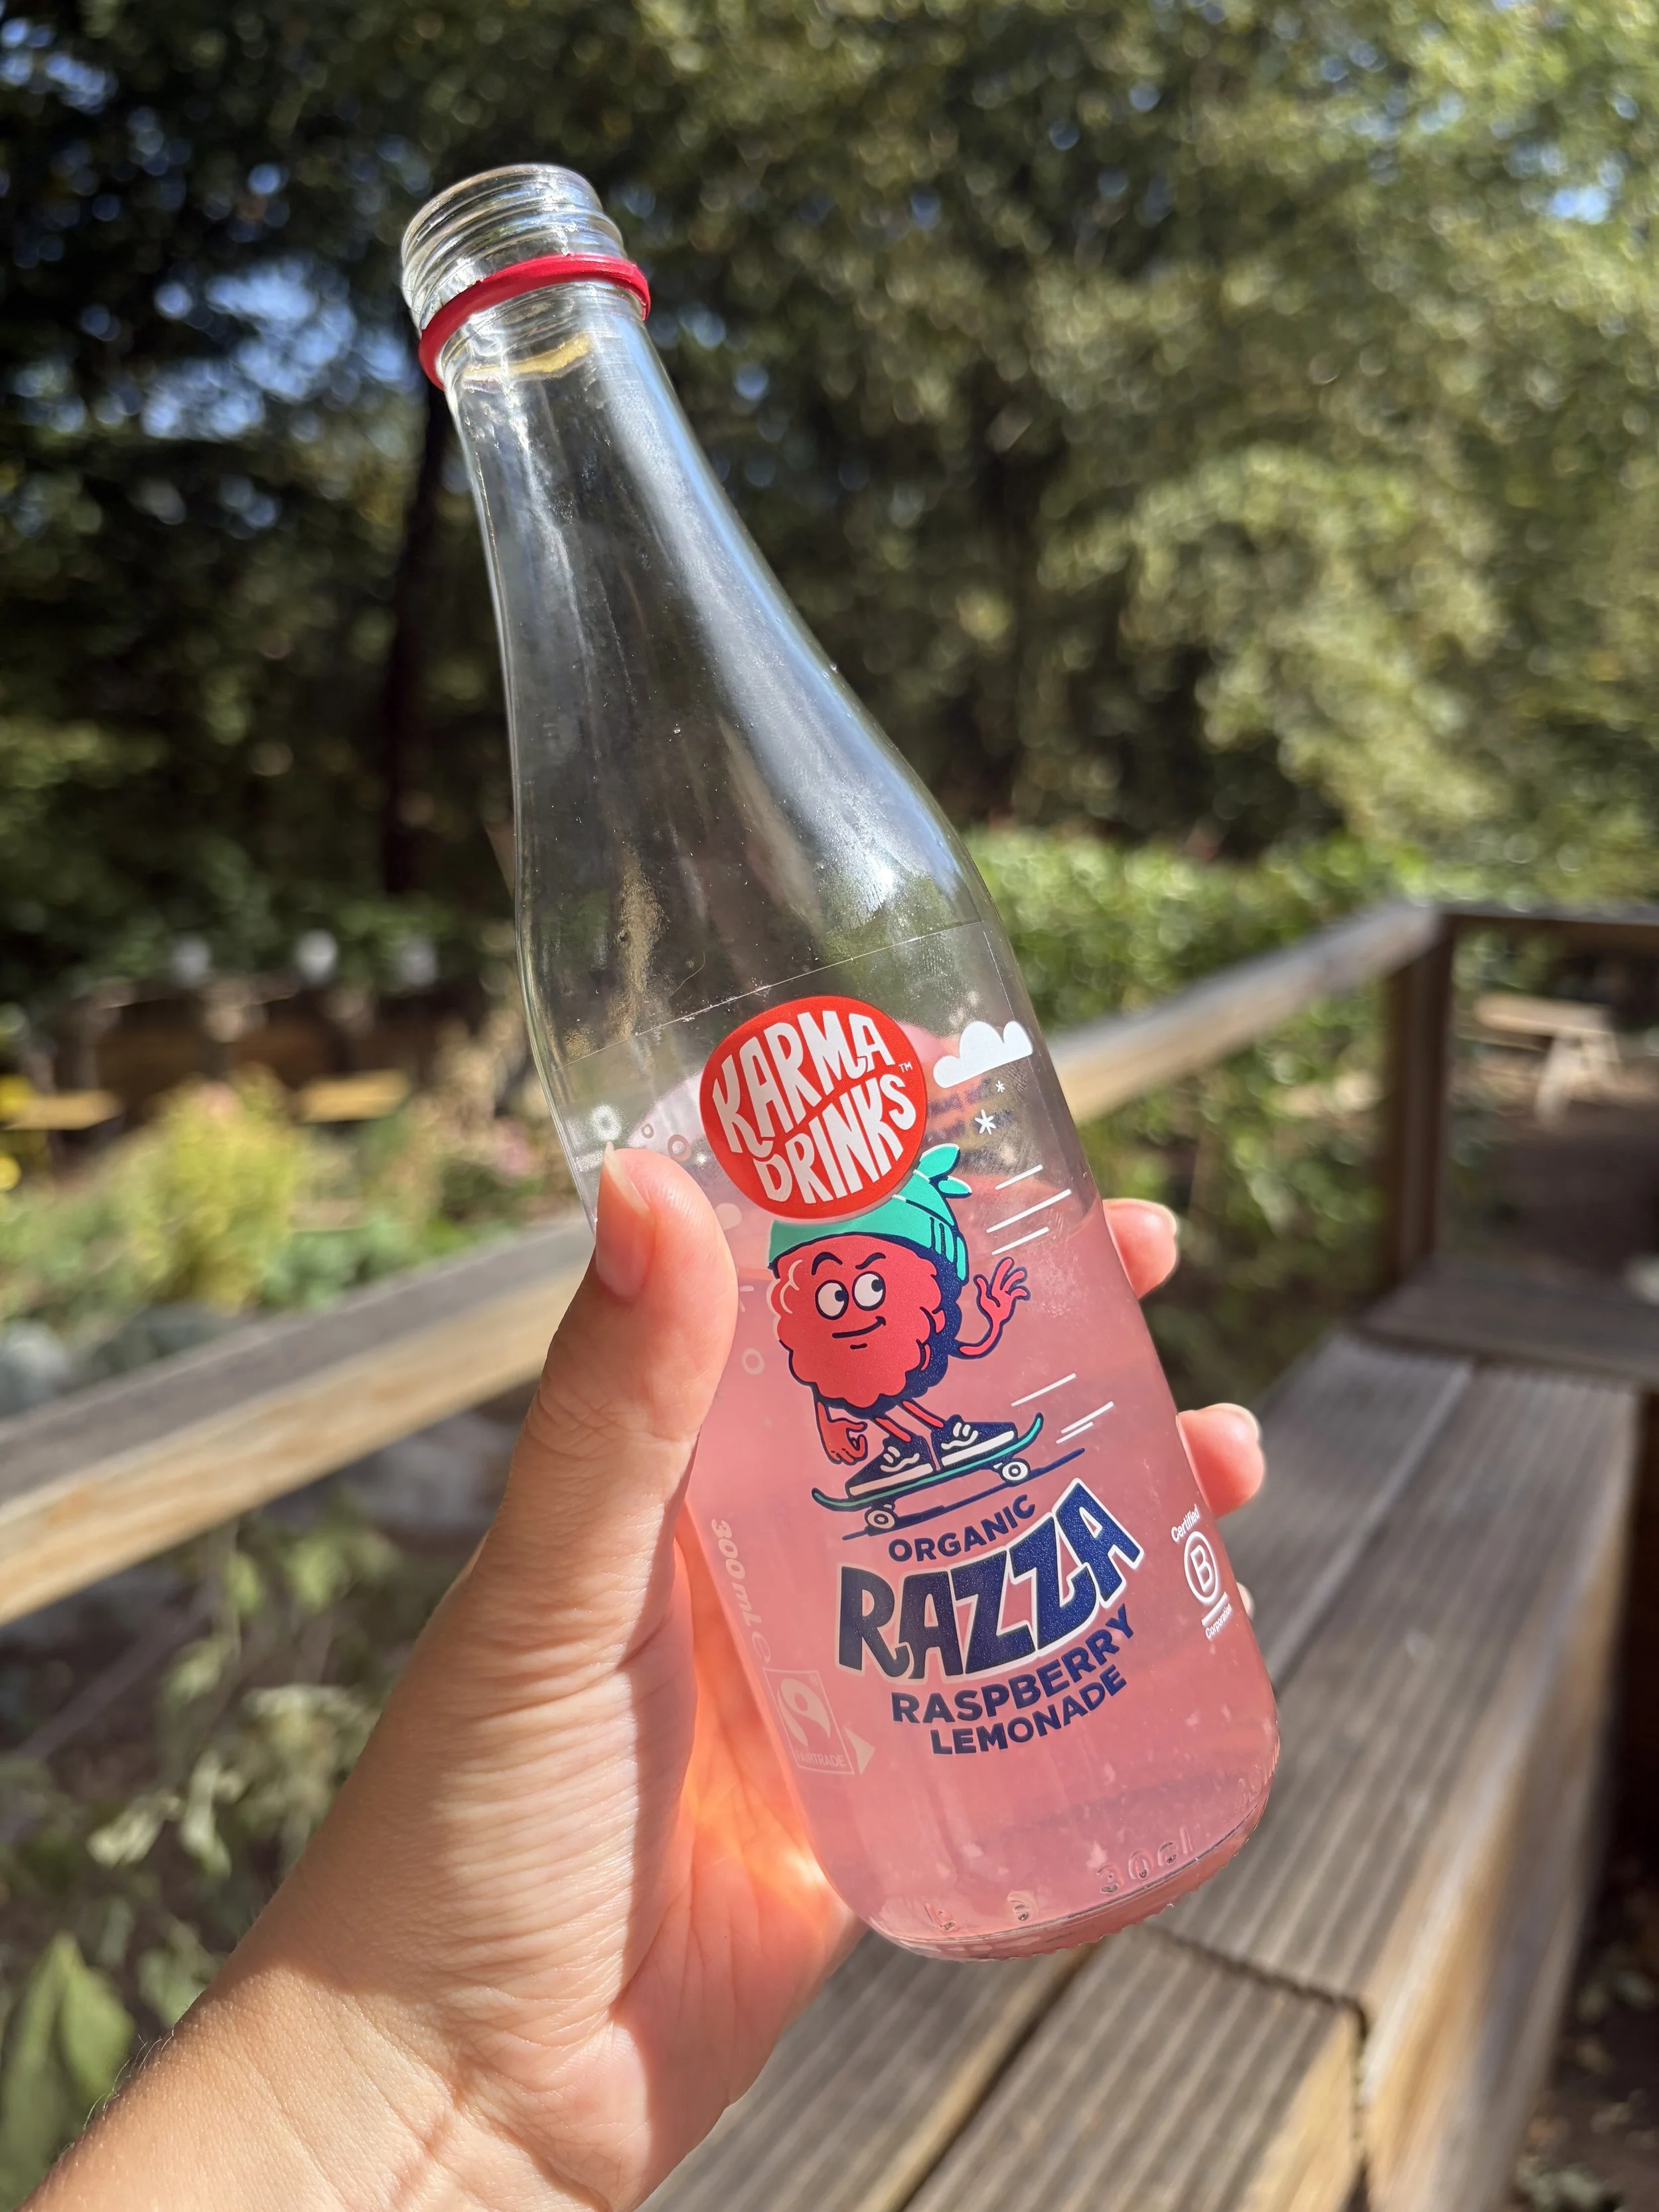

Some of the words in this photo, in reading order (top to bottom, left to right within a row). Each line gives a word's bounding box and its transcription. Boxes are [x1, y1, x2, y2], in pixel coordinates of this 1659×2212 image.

[712, 1010, 896, 1158] KARMA
[754, 1073, 916, 1204] DRINKS
[711, 1518, 745, 1580] 300
[888, 1493, 1036, 1562] ORGANIC
[1171, 1503, 1200, 1543] Certified
[836, 1479, 1143, 1683] RAZZA
[1190, 1544, 1212, 1592] B
[1204, 1603, 1232, 1640] Corporation
[891, 1603, 1134, 1724] RASPBERRY
[930, 1664, 1127, 1755] LEMONADE
[796, 1751, 846, 1767] FAIRTRADE
